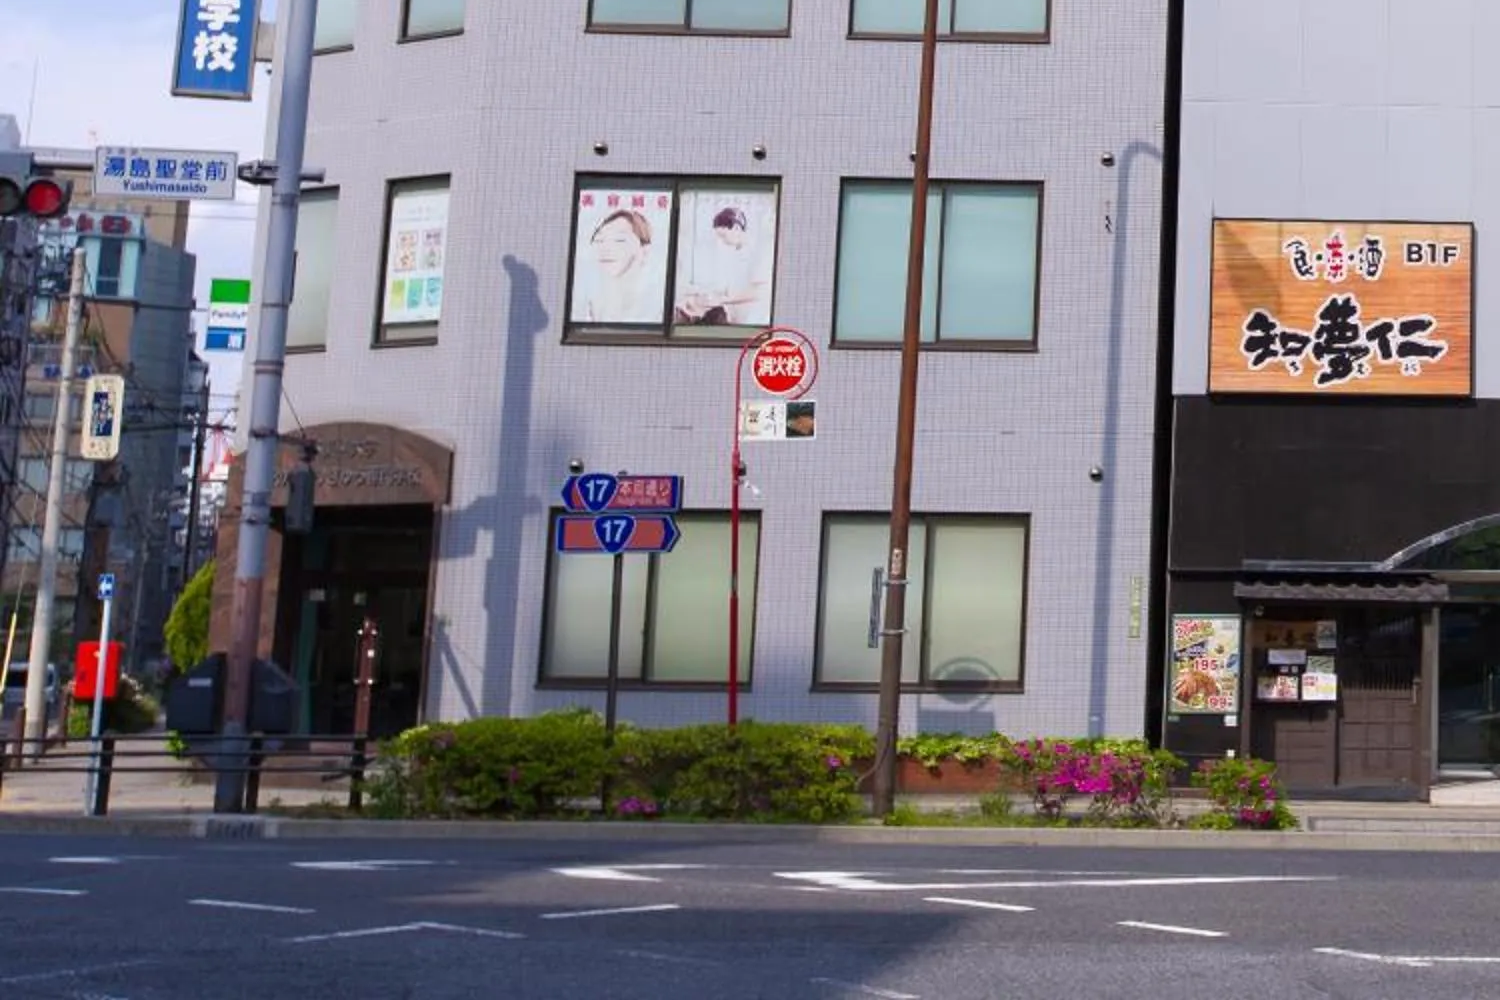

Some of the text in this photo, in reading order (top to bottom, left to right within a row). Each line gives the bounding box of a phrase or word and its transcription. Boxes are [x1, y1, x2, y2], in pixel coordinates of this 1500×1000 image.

[103, 156, 228, 182] 湯島聖堂前
[122, 179, 208, 194] Yushimaseido
[1406, 242, 1458, 264] B1F
[1243, 296, 1446, 386] 知夢仁
[757, 354, 803, 377] 消火栓
[585, 479, 609, 503] 17
[602, 519, 627, 543] 17
